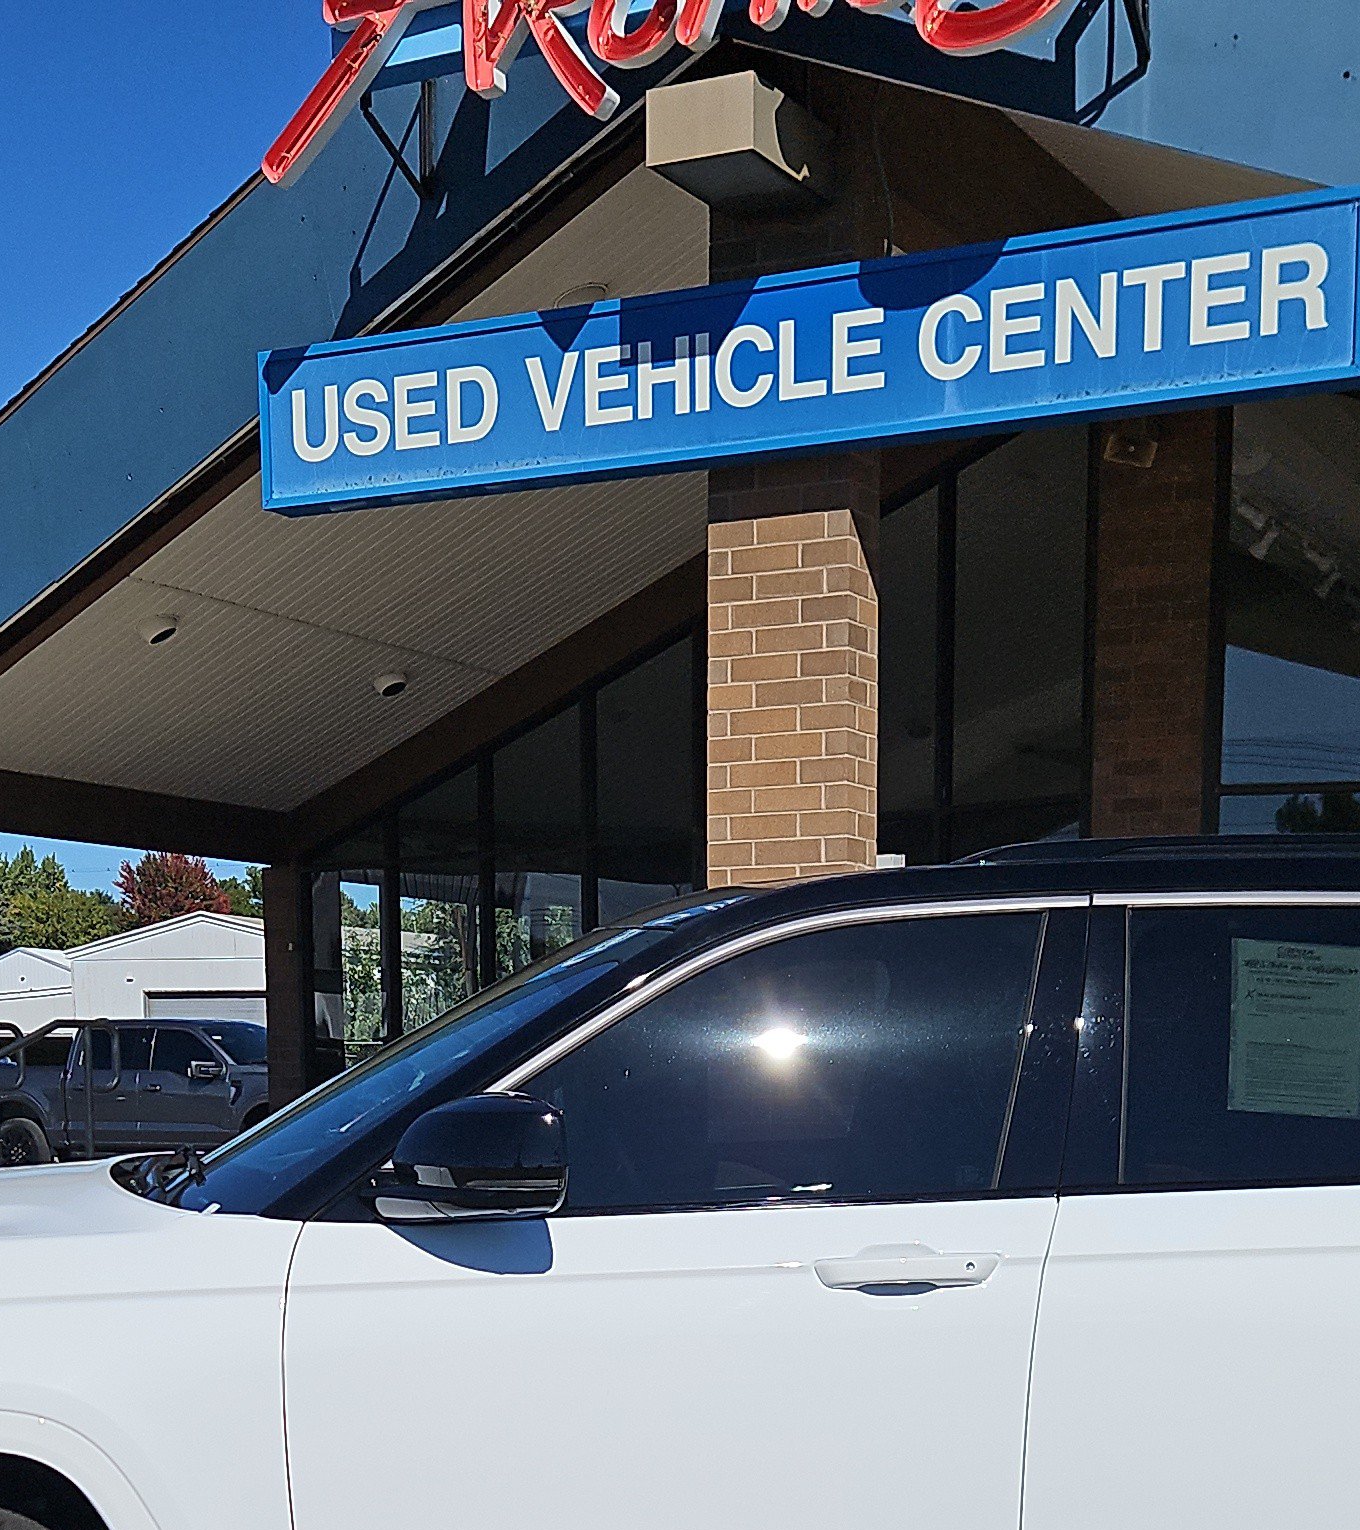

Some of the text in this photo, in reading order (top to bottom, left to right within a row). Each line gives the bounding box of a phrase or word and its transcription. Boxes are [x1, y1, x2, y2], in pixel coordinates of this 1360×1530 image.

[291, 242, 1329, 463] USED VEHICLE CENTER
